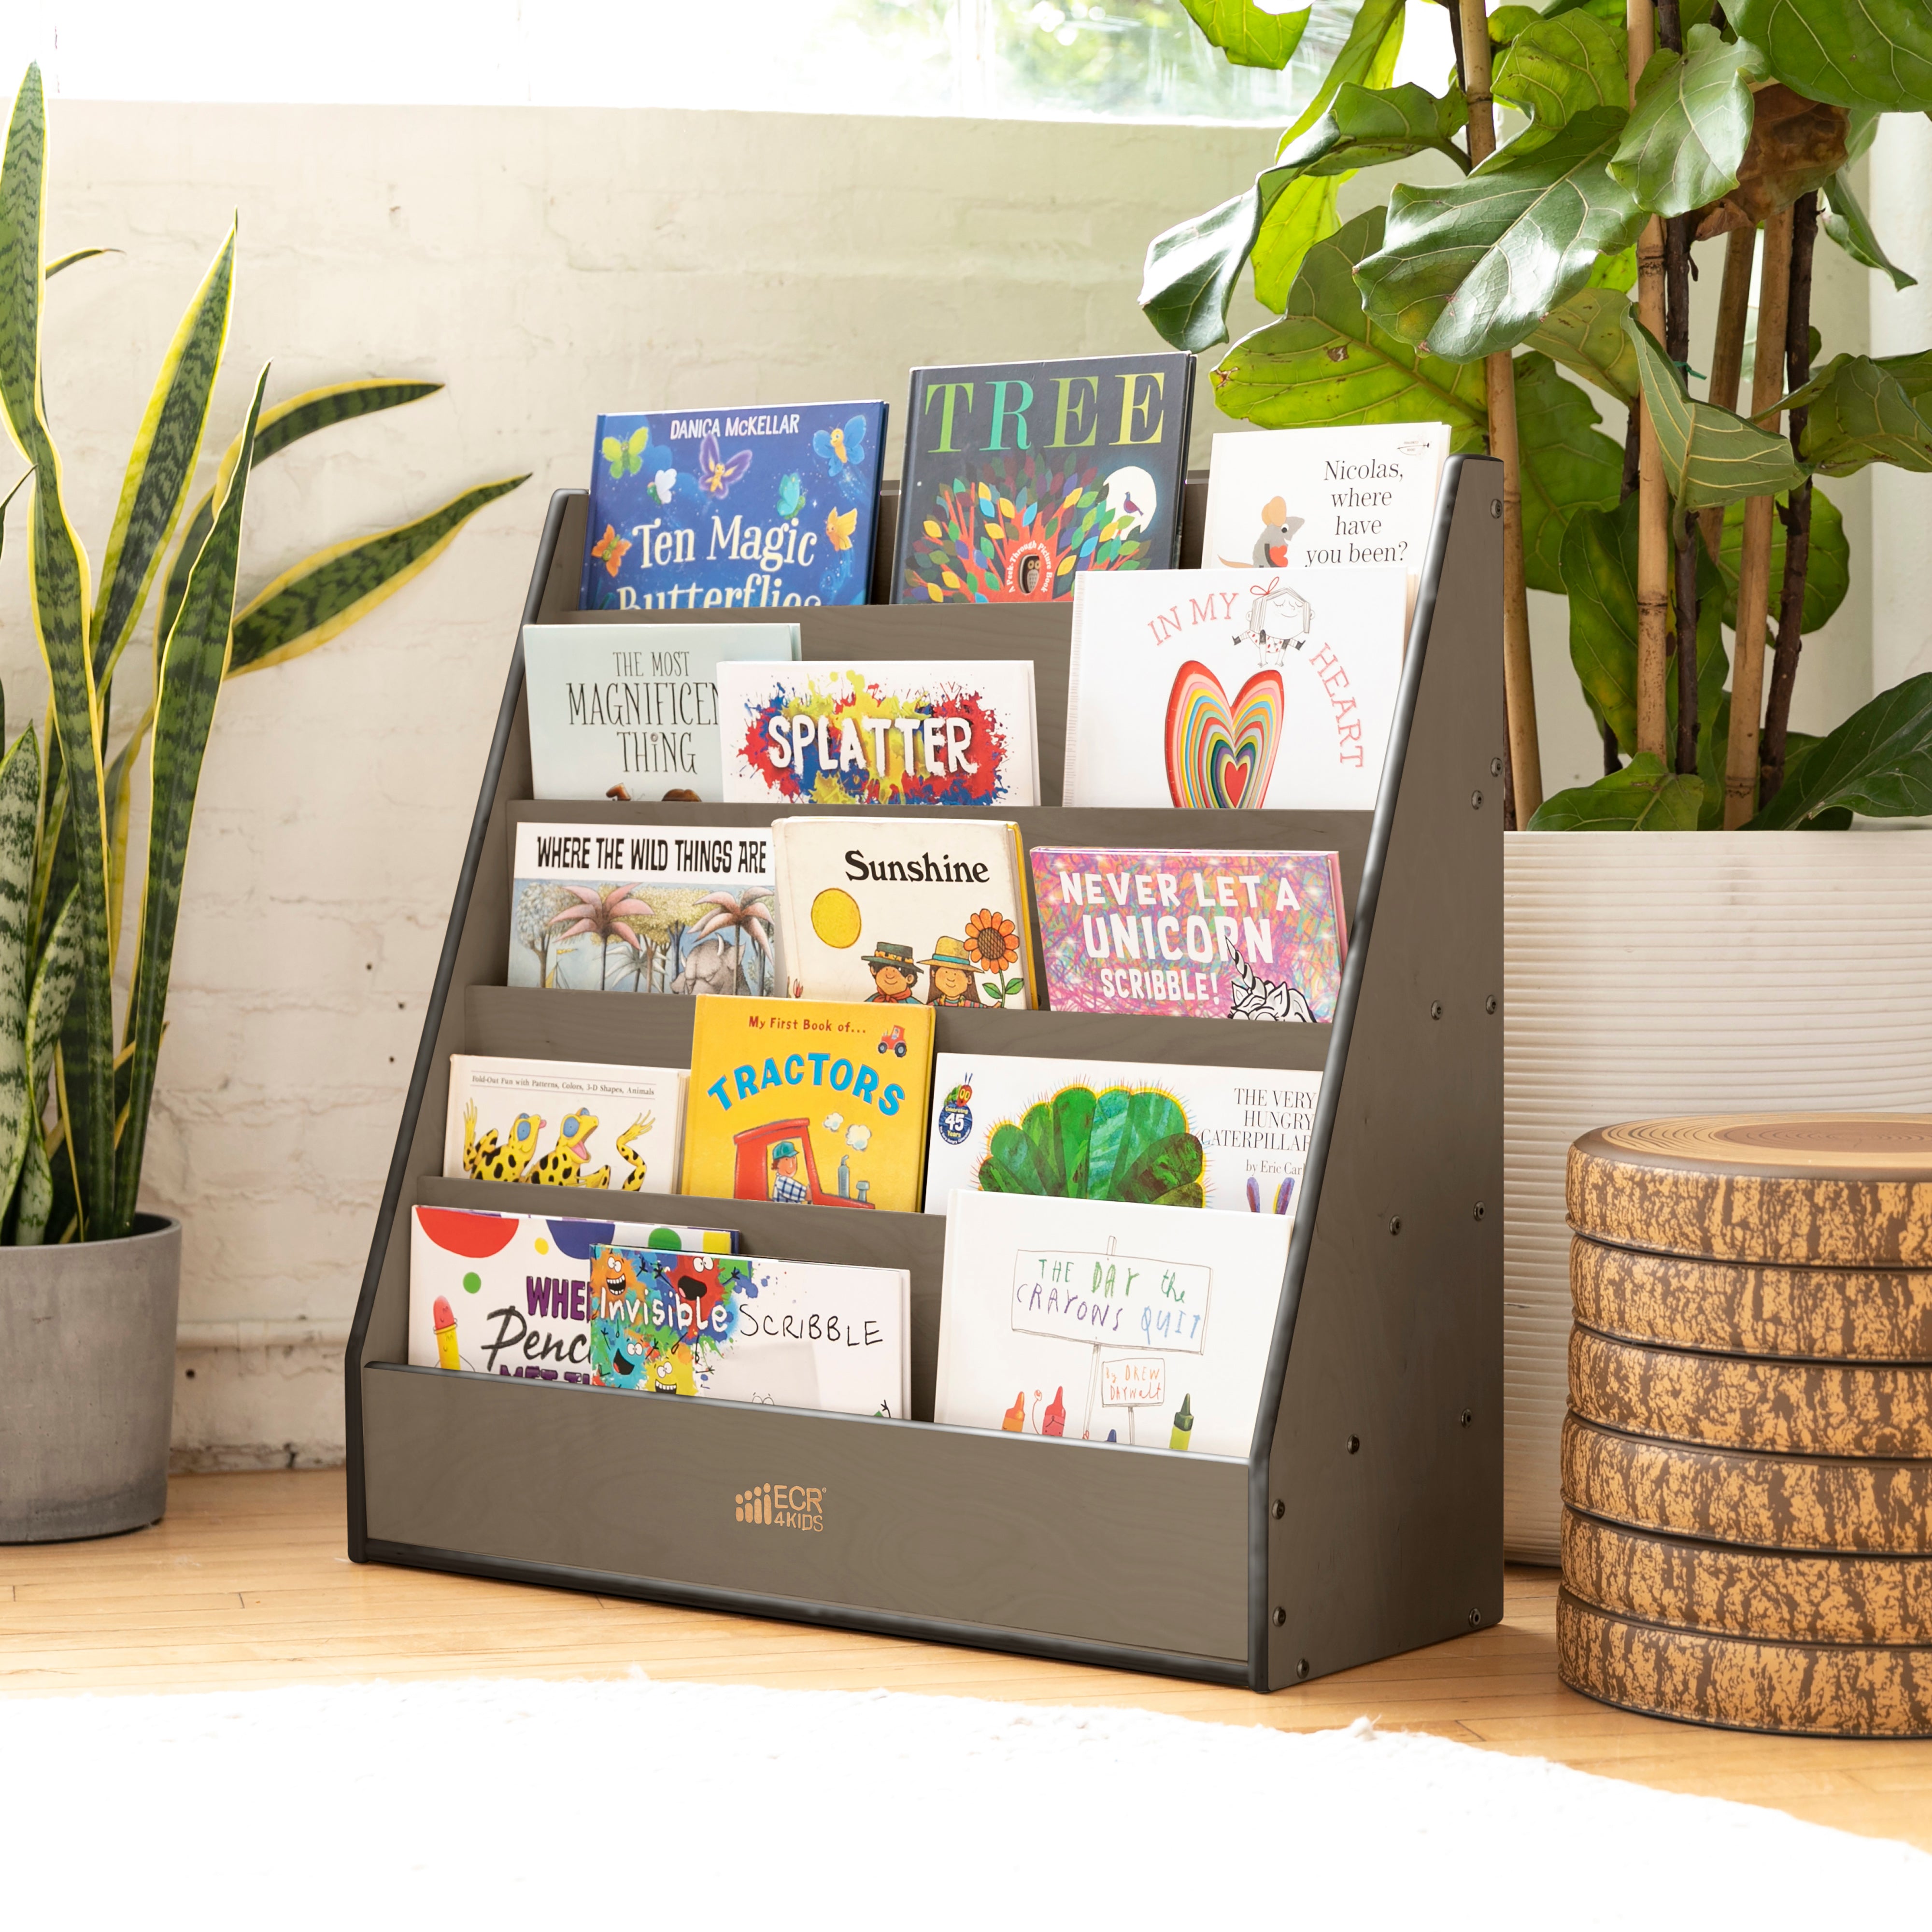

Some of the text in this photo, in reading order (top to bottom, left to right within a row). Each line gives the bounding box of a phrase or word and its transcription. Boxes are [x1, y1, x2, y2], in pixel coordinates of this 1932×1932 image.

[924, 372, 1165, 453] TREE
[670, 418, 720, 440] DANICA
[1323, 458, 1403, 482] Nicolas,
[1331, 488, 1392, 508] where
[1335, 516, 1381, 536] have
[632, 515, 816, 572] Ten Magic
[1037, 543, 1051, 569] Picture
[1305, 541, 1407, 567] you been?
[1040, 572, 1053, 593] Book
[1148, 593, 1239, 646] IN MY
[613, 651, 689, 676] THE MOST
[1308, 642, 1364, 768] HEART
[768, 714, 981, 777] SPLATTER
[537, 836, 767, 873] WHERE THE WILD THINGS ARE
[845, 850, 990, 882] Sunshine
[1059, 871, 1301, 911] NEVER LET A
[1082, 913, 1274, 964] UNICORN
[1100, 968, 1220, 1005] SCRIBBLE!
[749, 1016, 866, 1033] My First Book of...
[472, 1076, 498, 1084] Fold-Out
[532, 1080, 559, 1089] Patterns,
[562, 1082, 583, 1091] Colors,
[600, 1085, 624, 1094] Shapes,
[707, 1052, 905, 1116] TRACTORS
[1234, 1088, 1317, 1109] THE VERY
[945, 1113, 965, 1131] 45
[1243, 1110, 1314, 1130] HUNGRY
[1246, 1159, 1258, 1176] by
[1261, 1160, 1281, 1173] Eric
[1038, 1259, 1185, 1304] THE DAY the
[526, 1276, 590, 1323] WHE
[1017, 1283, 1200, 1345] CRAYONS QUIT
[481, 1306, 590, 1372] Penc
[739, 1304, 883, 1347] SCRIBBLE
[1125, 1364, 1160, 1381] DREW
[774, 1511, 824, 1532] 4KIDS
